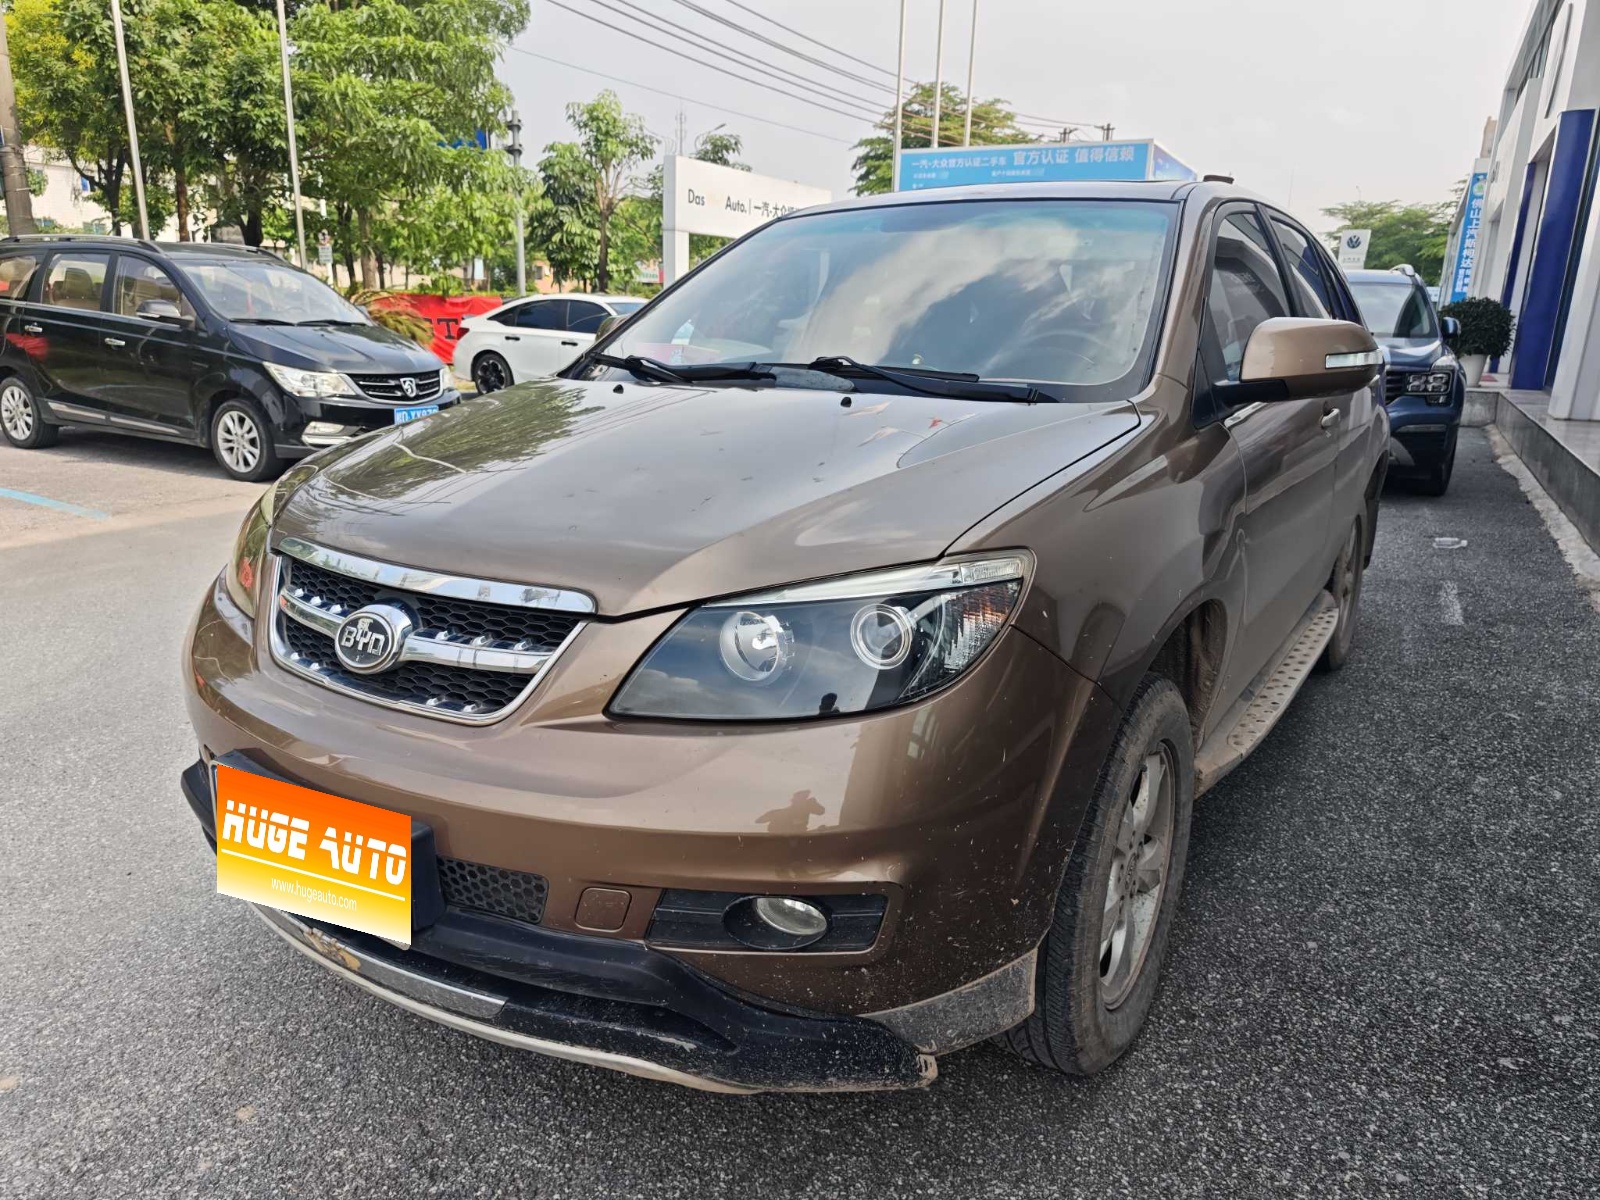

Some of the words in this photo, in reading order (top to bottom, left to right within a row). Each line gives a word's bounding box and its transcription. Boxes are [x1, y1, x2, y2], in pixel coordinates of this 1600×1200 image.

[1013, 149, 1069, 166] 官方认证
[1075, 146, 1135, 163] 值得信赖
[688, 188, 705, 206] Das
[725, 196, 747, 214] Auto.
